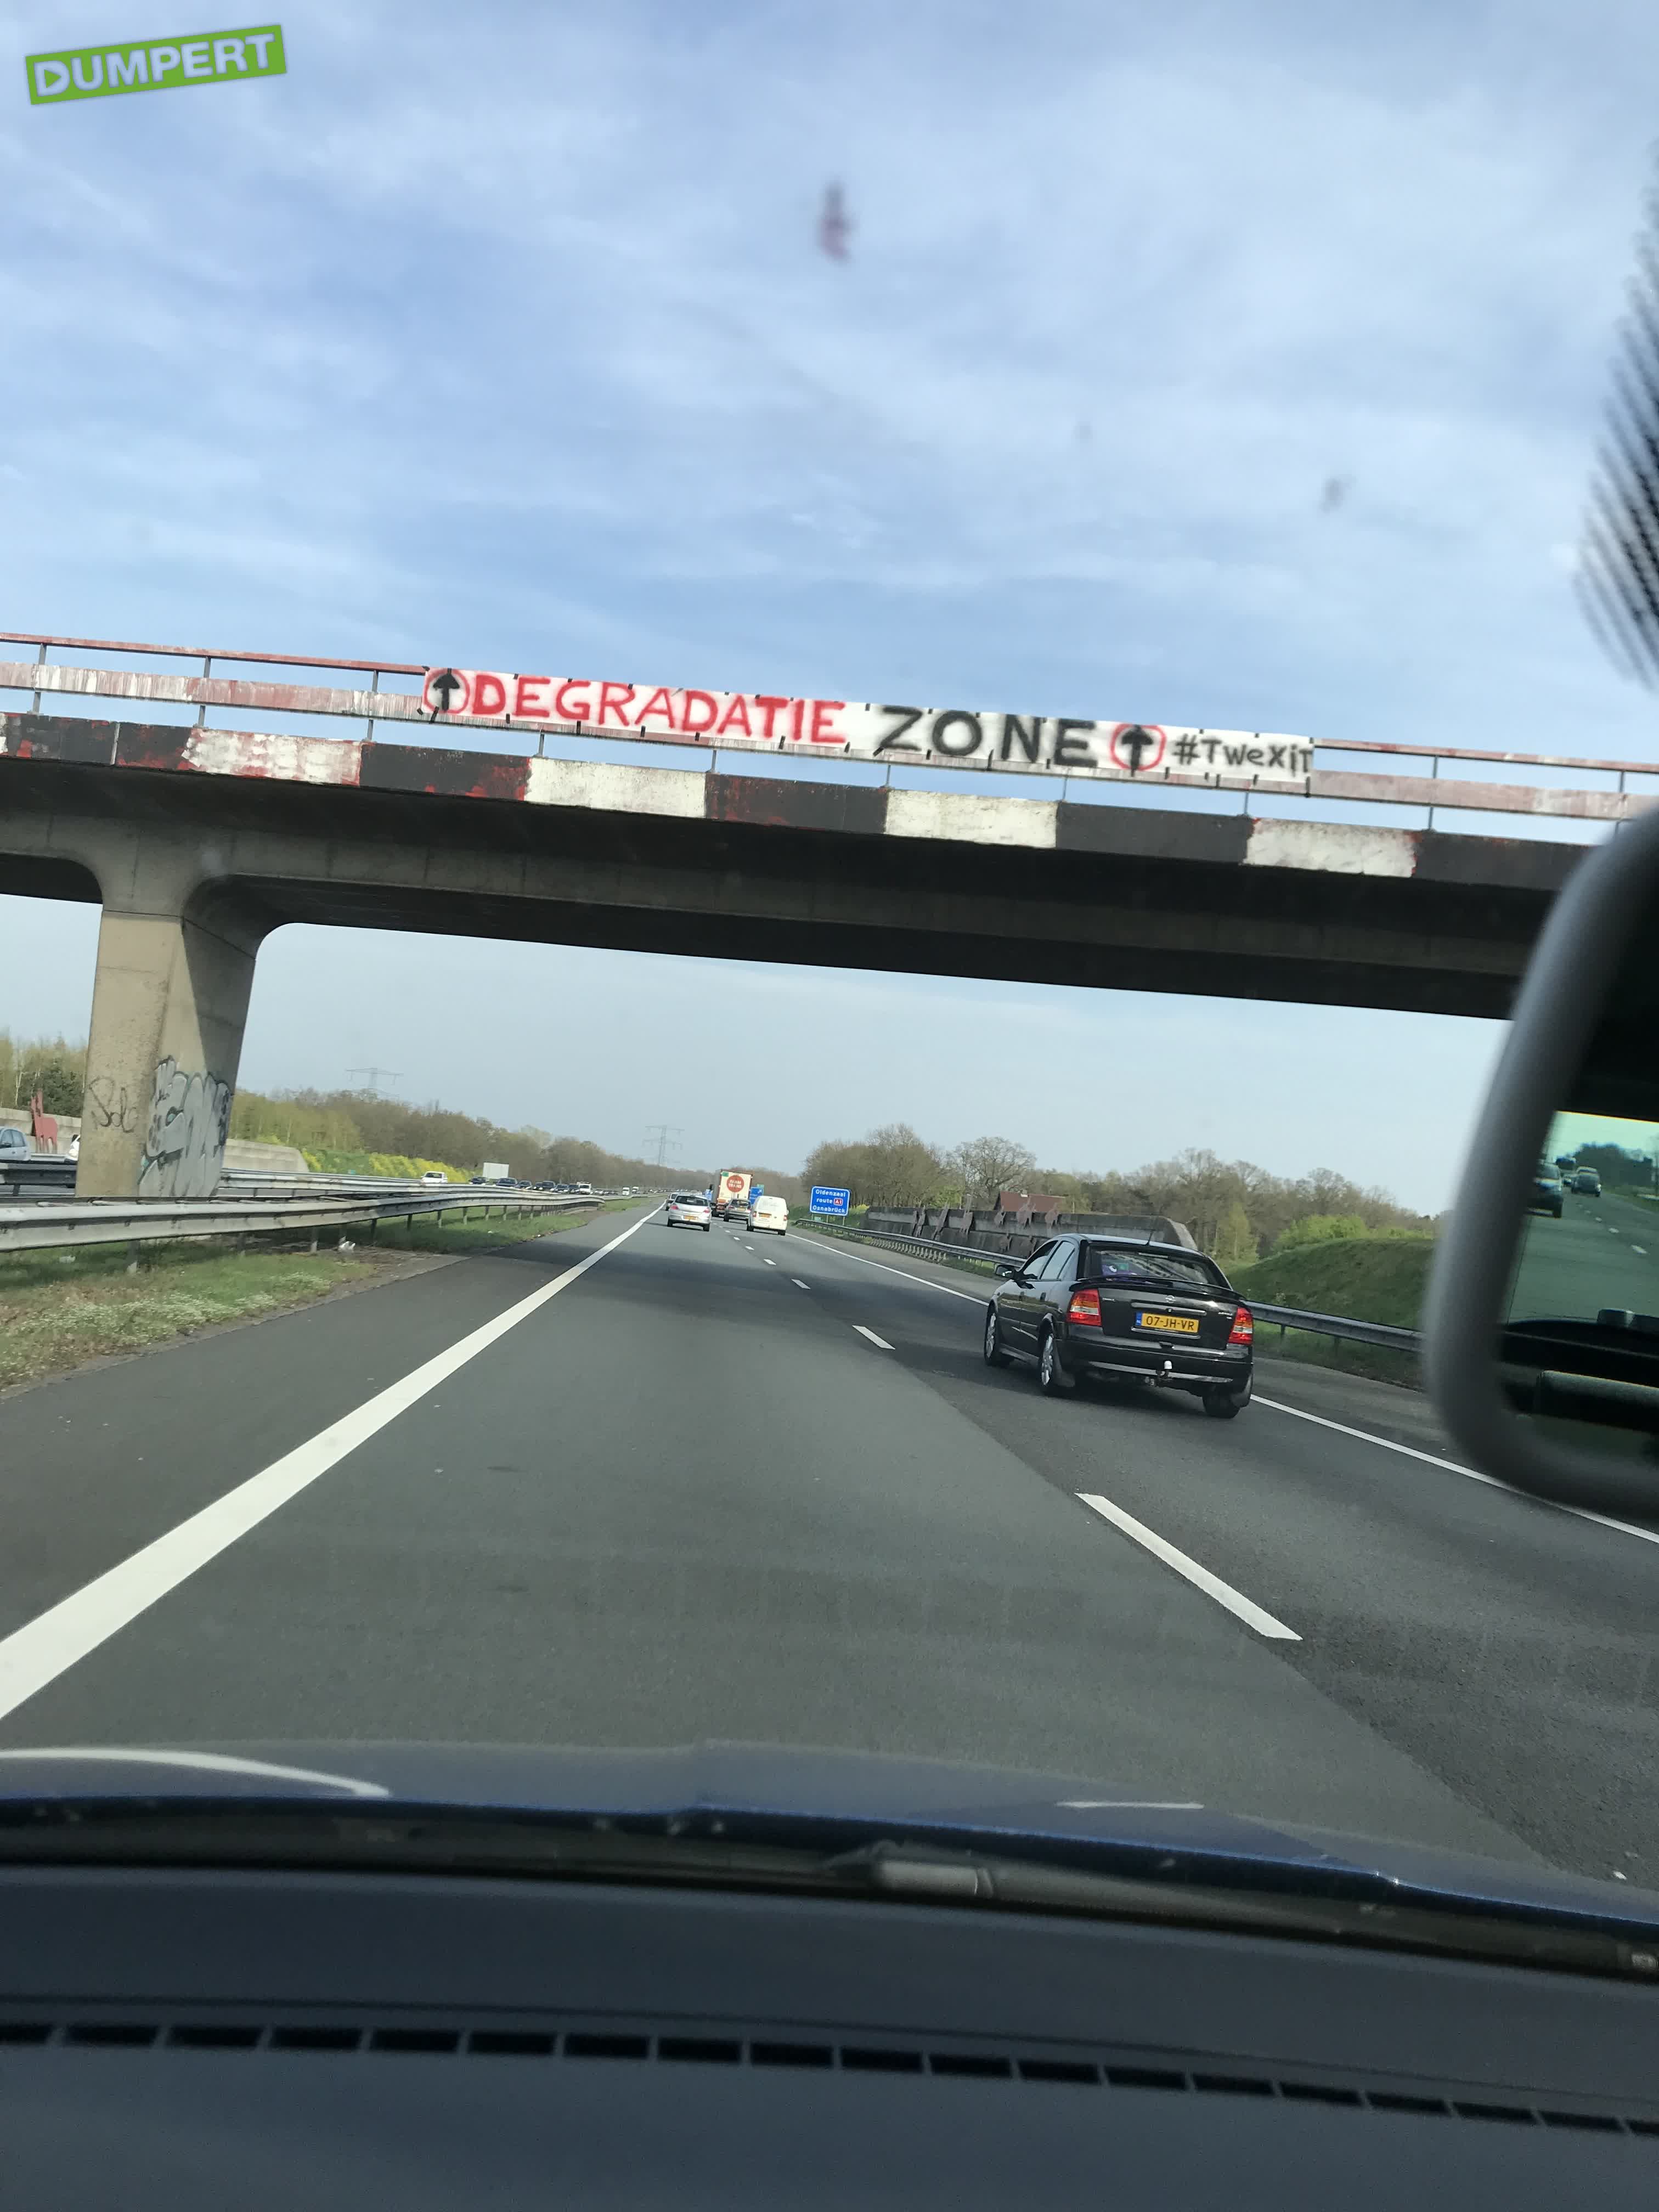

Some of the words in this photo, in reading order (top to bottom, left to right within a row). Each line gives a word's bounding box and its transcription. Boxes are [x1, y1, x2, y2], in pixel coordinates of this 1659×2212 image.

[472, 674, 846, 743] DEGRADATIE
[879, 705, 1097, 767] ZONE
[1146, 1316, 1195, 1330] 07-JH-VR
